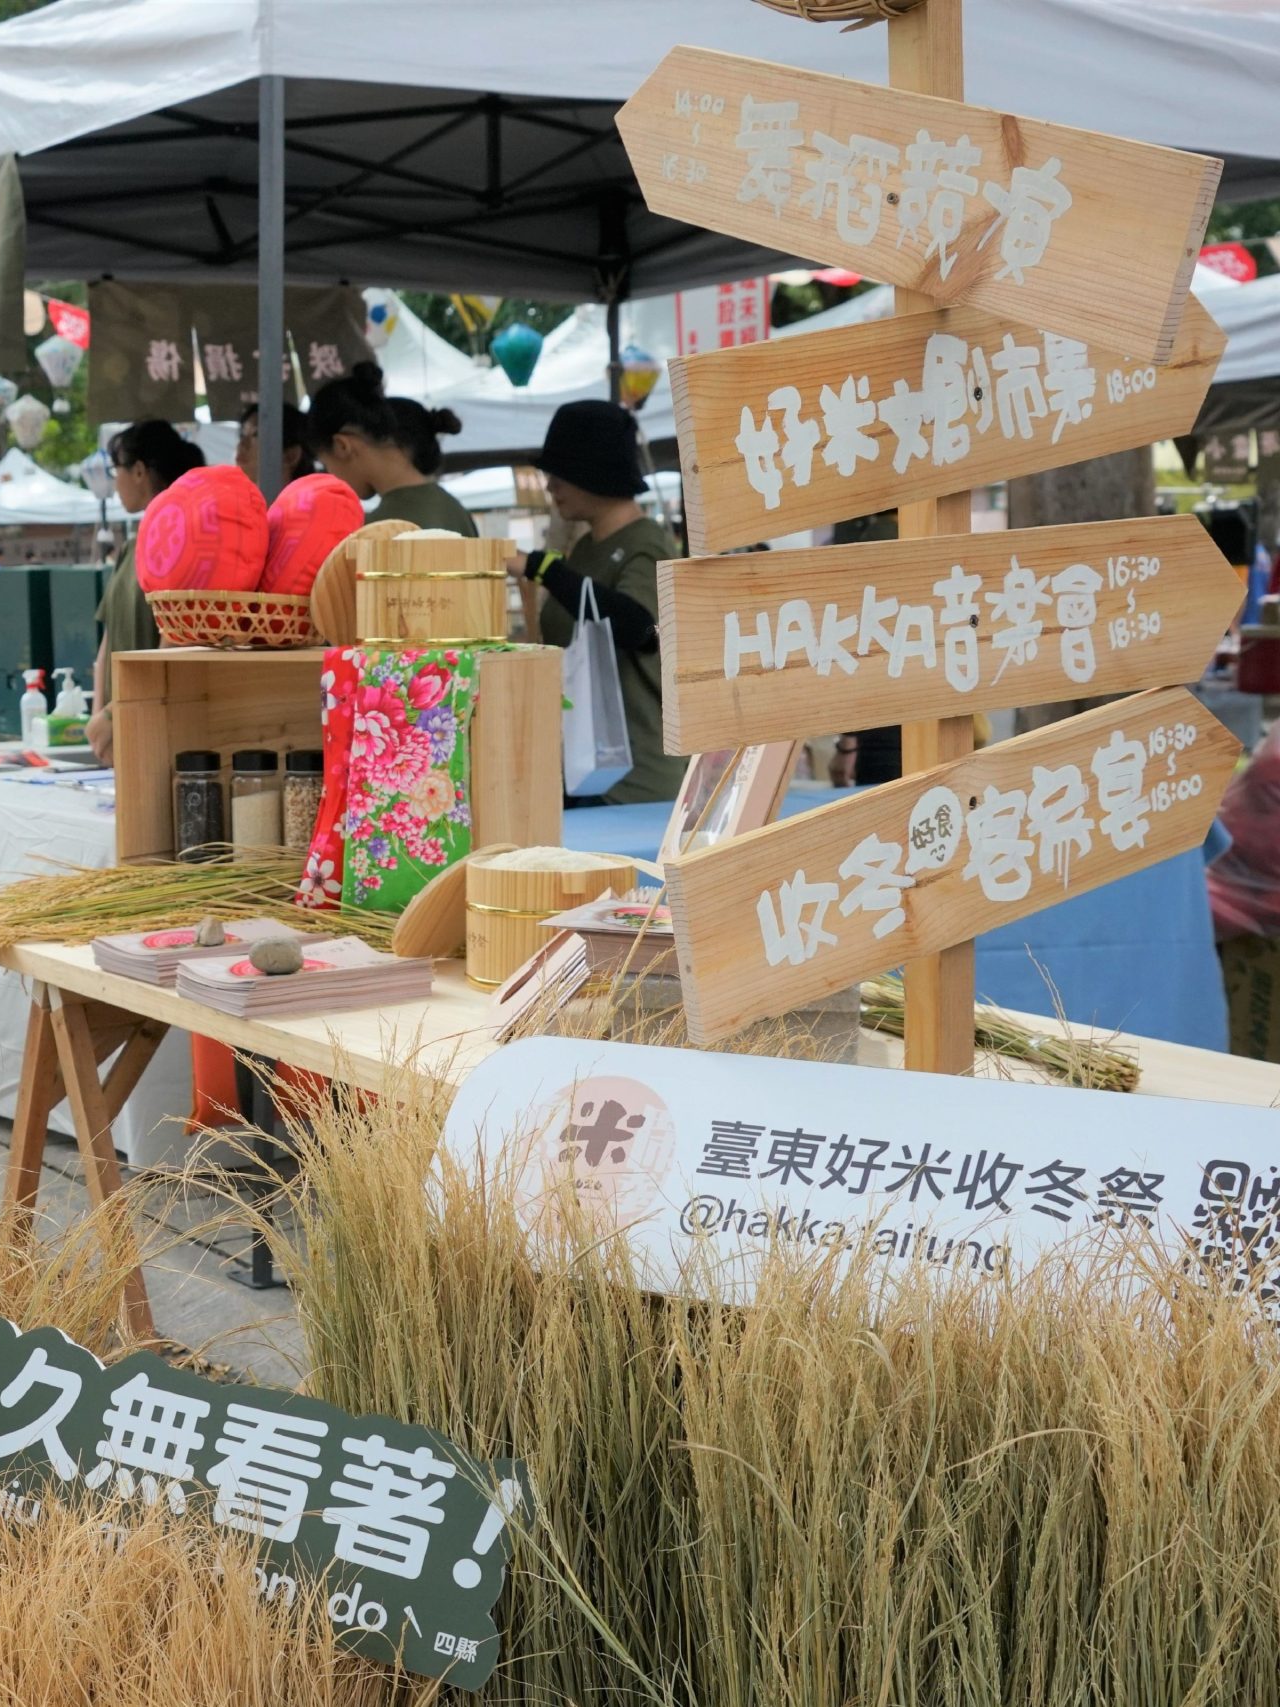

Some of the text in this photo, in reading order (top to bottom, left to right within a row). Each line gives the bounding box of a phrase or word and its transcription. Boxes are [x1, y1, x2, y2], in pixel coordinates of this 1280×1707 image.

[1106, 368, 1157, 405] 18:00
[1107, 556, 1160, 590] 16:30
[1109, 611, 1160, 650] 18:30
[1149, 723, 1196, 757] 16:30
[1150, 775, 1202, 812] 18:00
[696, 1120, 1165, 1230] 臺東好米收冬祭
[434, 1631, 478, 1664] 四縣
